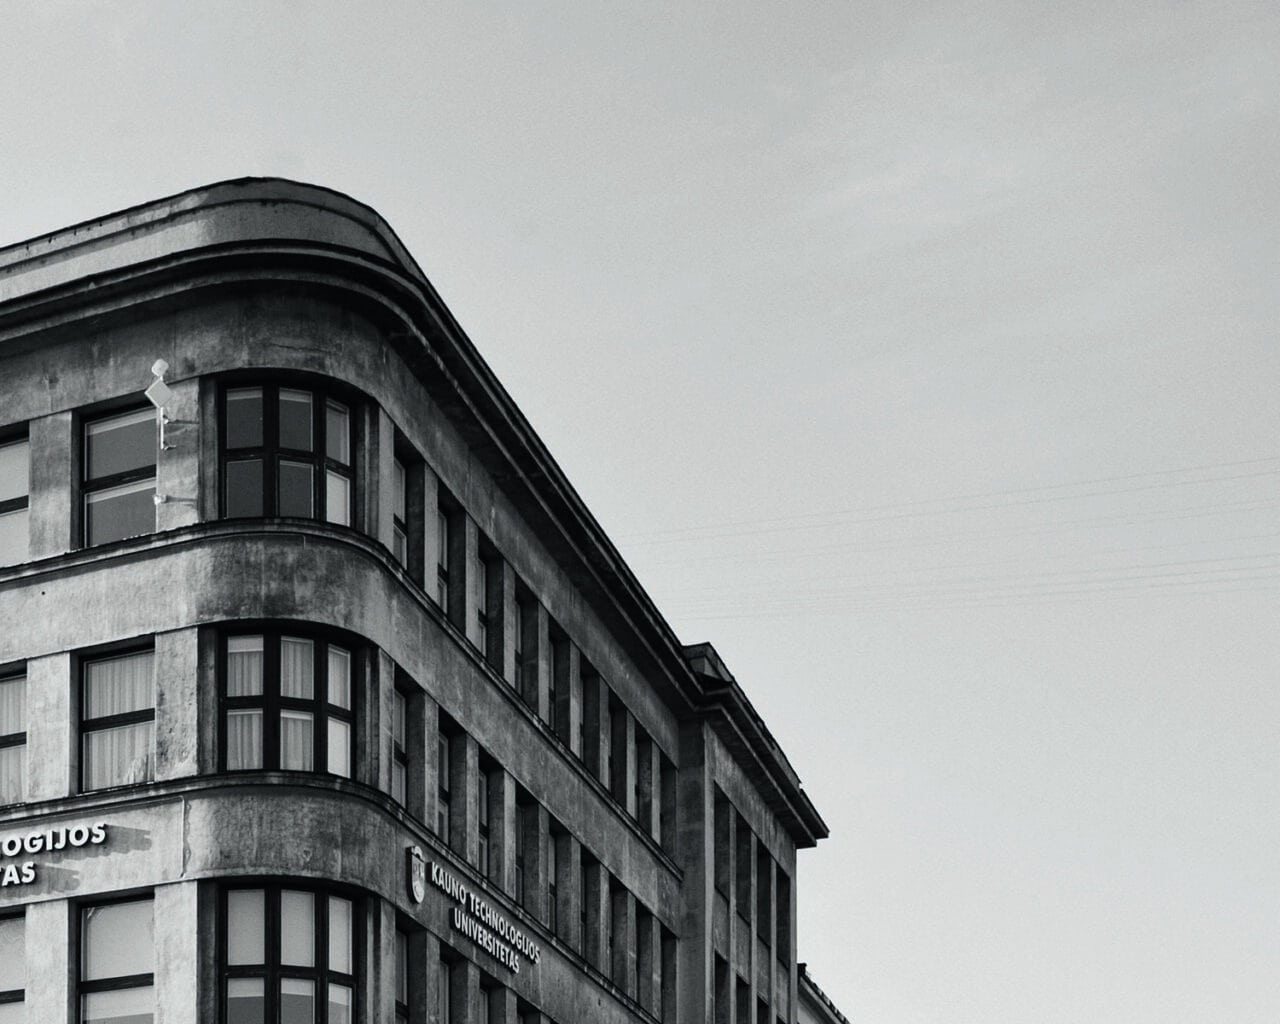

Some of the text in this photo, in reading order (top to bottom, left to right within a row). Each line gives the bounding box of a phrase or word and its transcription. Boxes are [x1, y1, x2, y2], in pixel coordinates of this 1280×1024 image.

[431, 860, 541, 965] KAUNO TECHNOLOGIJOS
[454, 906, 520, 974] UNIVERSITETAS
